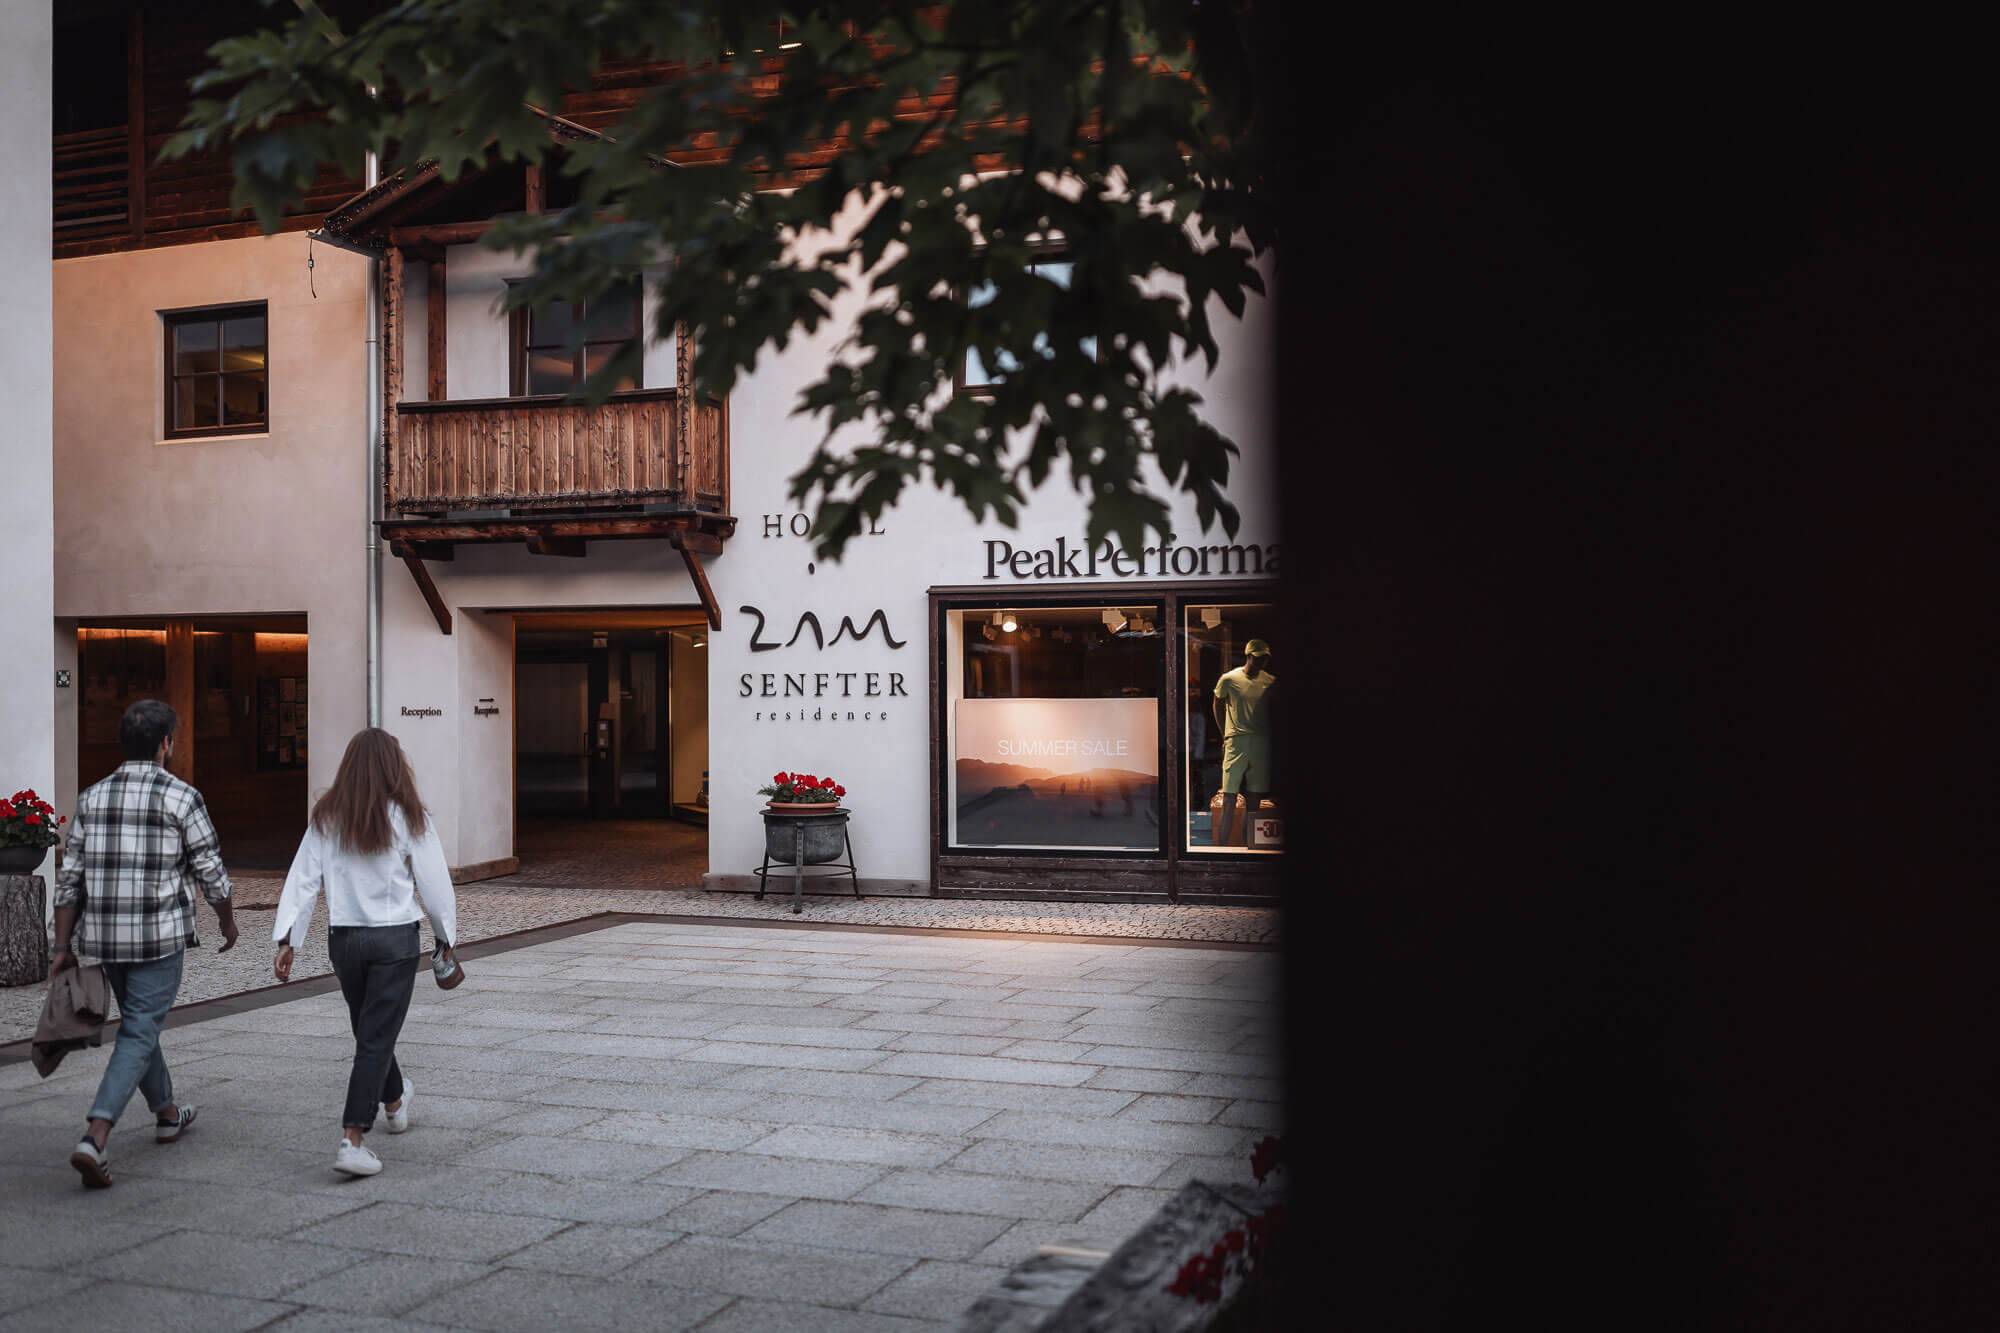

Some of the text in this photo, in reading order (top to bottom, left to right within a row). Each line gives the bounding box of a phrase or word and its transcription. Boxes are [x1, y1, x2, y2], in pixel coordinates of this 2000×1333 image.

[763, 513, 885, 538] HOL
[739, 672, 908, 697] SENFTER
[401, 706, 442, 718] Reception
[756, 707, 887, 720] residence
[998, 739, 1128, 756] SUMMER SALE
